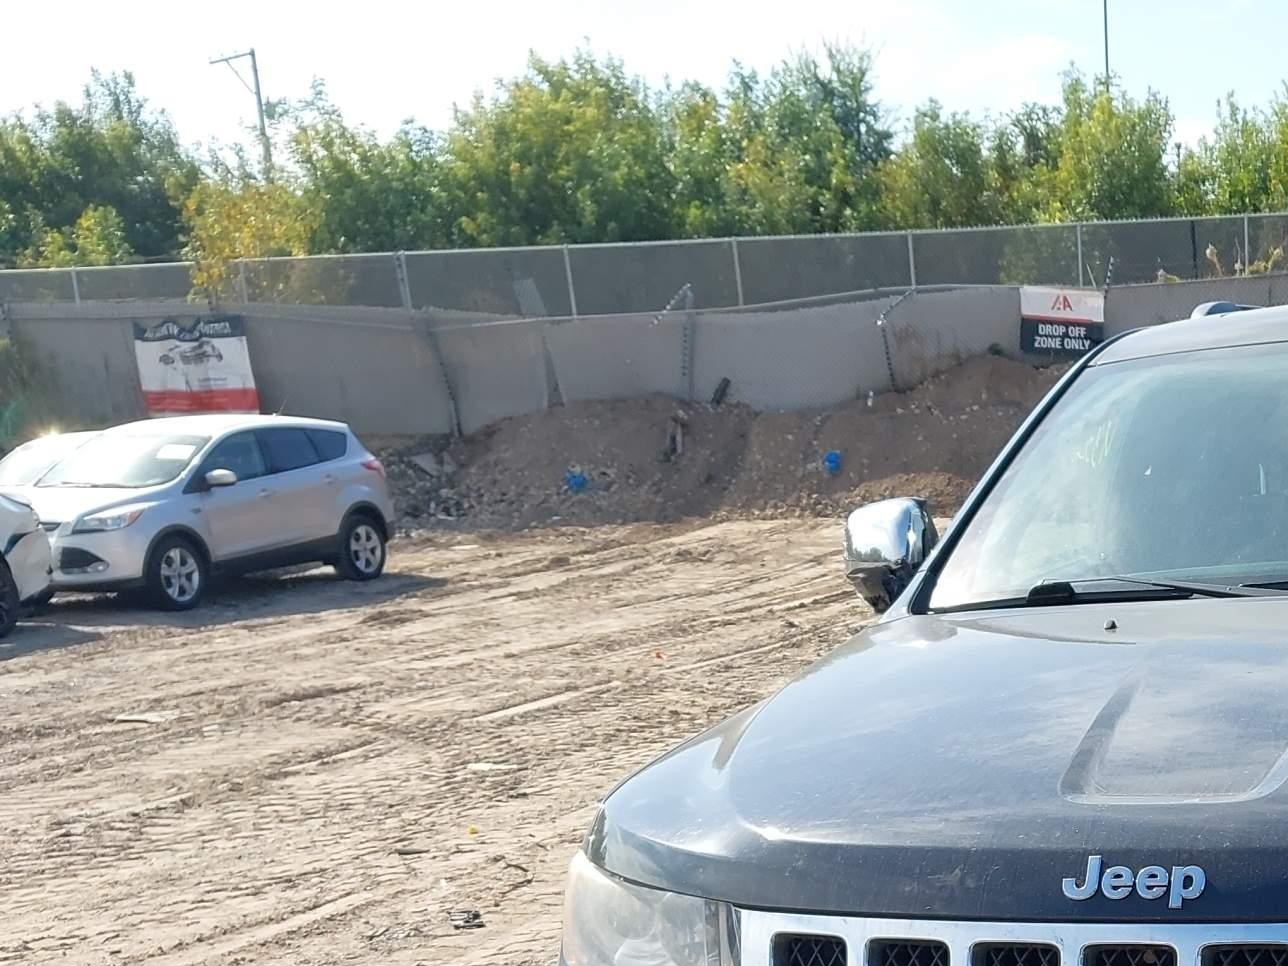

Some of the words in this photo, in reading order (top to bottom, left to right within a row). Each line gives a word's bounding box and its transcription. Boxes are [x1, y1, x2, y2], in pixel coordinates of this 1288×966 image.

[1038, 324, 1066, 336] DROP
[1068, 327, 1087, 338] OFF
[1034, 336, 1062, 348] ZONE
[1063, 338, 1091, 350] ONLY
[1061, 854, 1207, 909] Jeep
